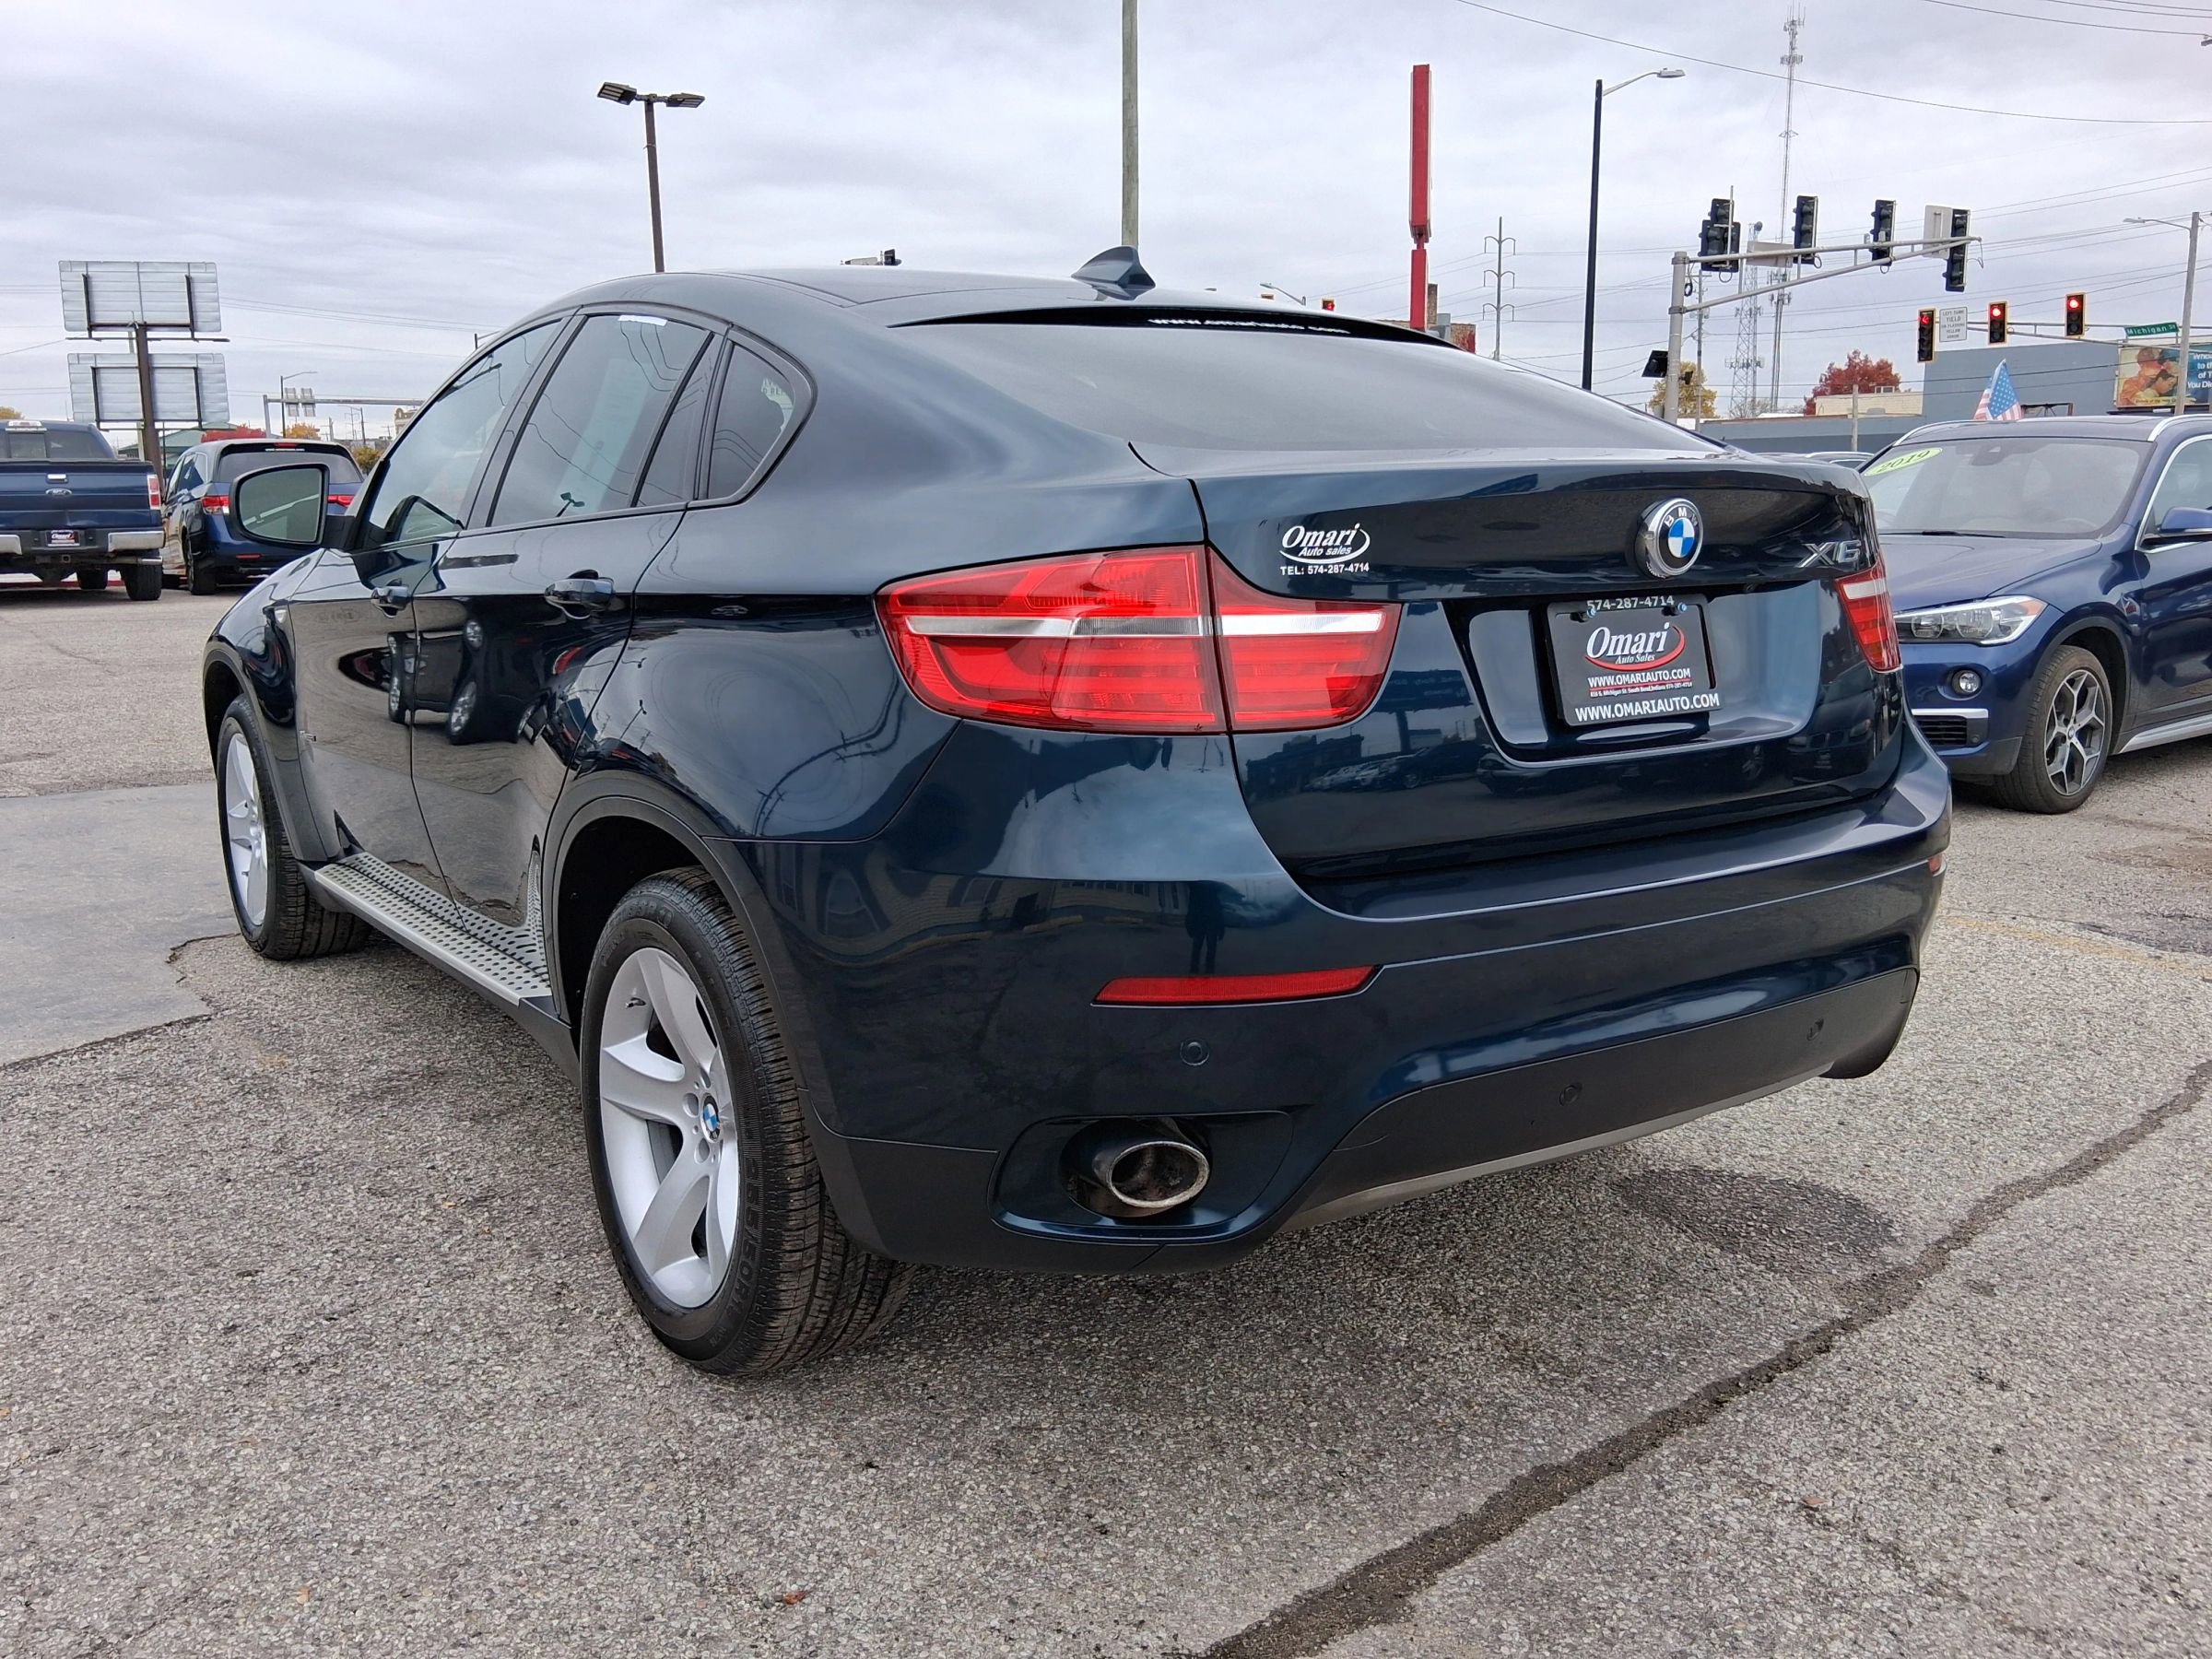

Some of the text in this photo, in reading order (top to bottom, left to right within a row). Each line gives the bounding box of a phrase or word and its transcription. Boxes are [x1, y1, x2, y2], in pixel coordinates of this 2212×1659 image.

[2126, 326, 2168, 335] Michigan
[2197, 371, 2206, 379] of
[1281, 523, 1360, 548] Omari
[1298, 546, 1353, 557] Auto sales
[1795, 538, 1862, 568] X6
[1279, 561, 1371, 576] TEL: 574-287-4714
[1586, 594, 1675, 611] 574-287-4714
[1586, 621, 1671, 658] Omari
[1615, 653, 1656, 665] Auto Sales
[1587, 667, 1691, 688] WWW.OMARIAUTO.COM
[1574, 692, 1721, 723] WWW.OMARIAUTO.COM
